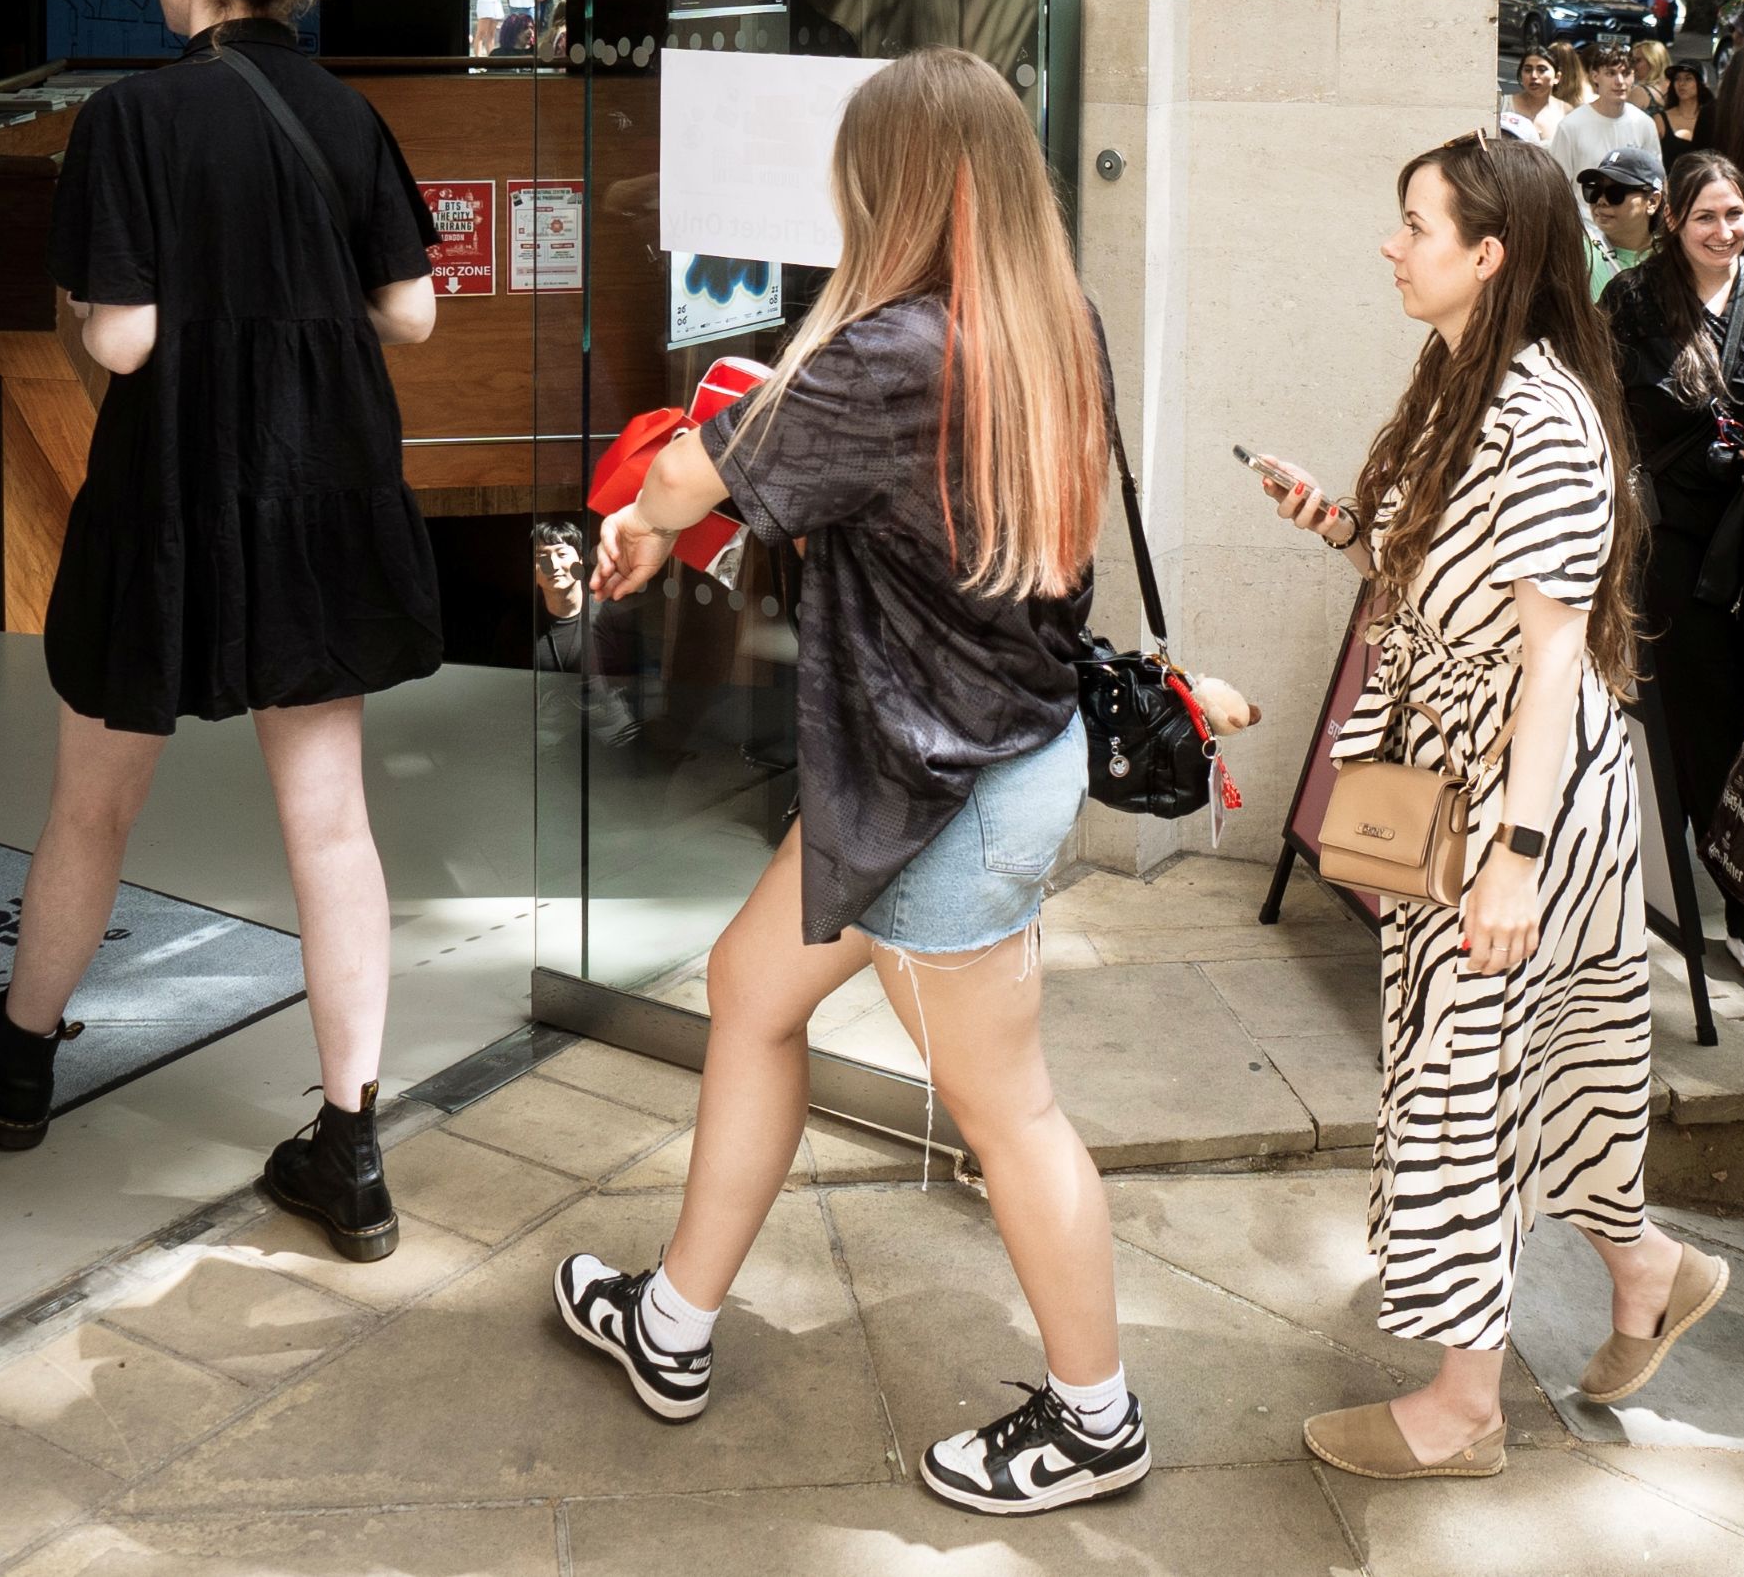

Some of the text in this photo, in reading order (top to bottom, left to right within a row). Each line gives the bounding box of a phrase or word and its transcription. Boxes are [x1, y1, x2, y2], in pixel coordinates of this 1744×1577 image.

[445, 201, 461, 210] BTS
[436, 211, 470, 221] THE CITY
[434, 222, 472, 231] ARIRANG
[441, 234, 465, 242] LONDON
[431, 266, 491, 277] USIC ZONE
